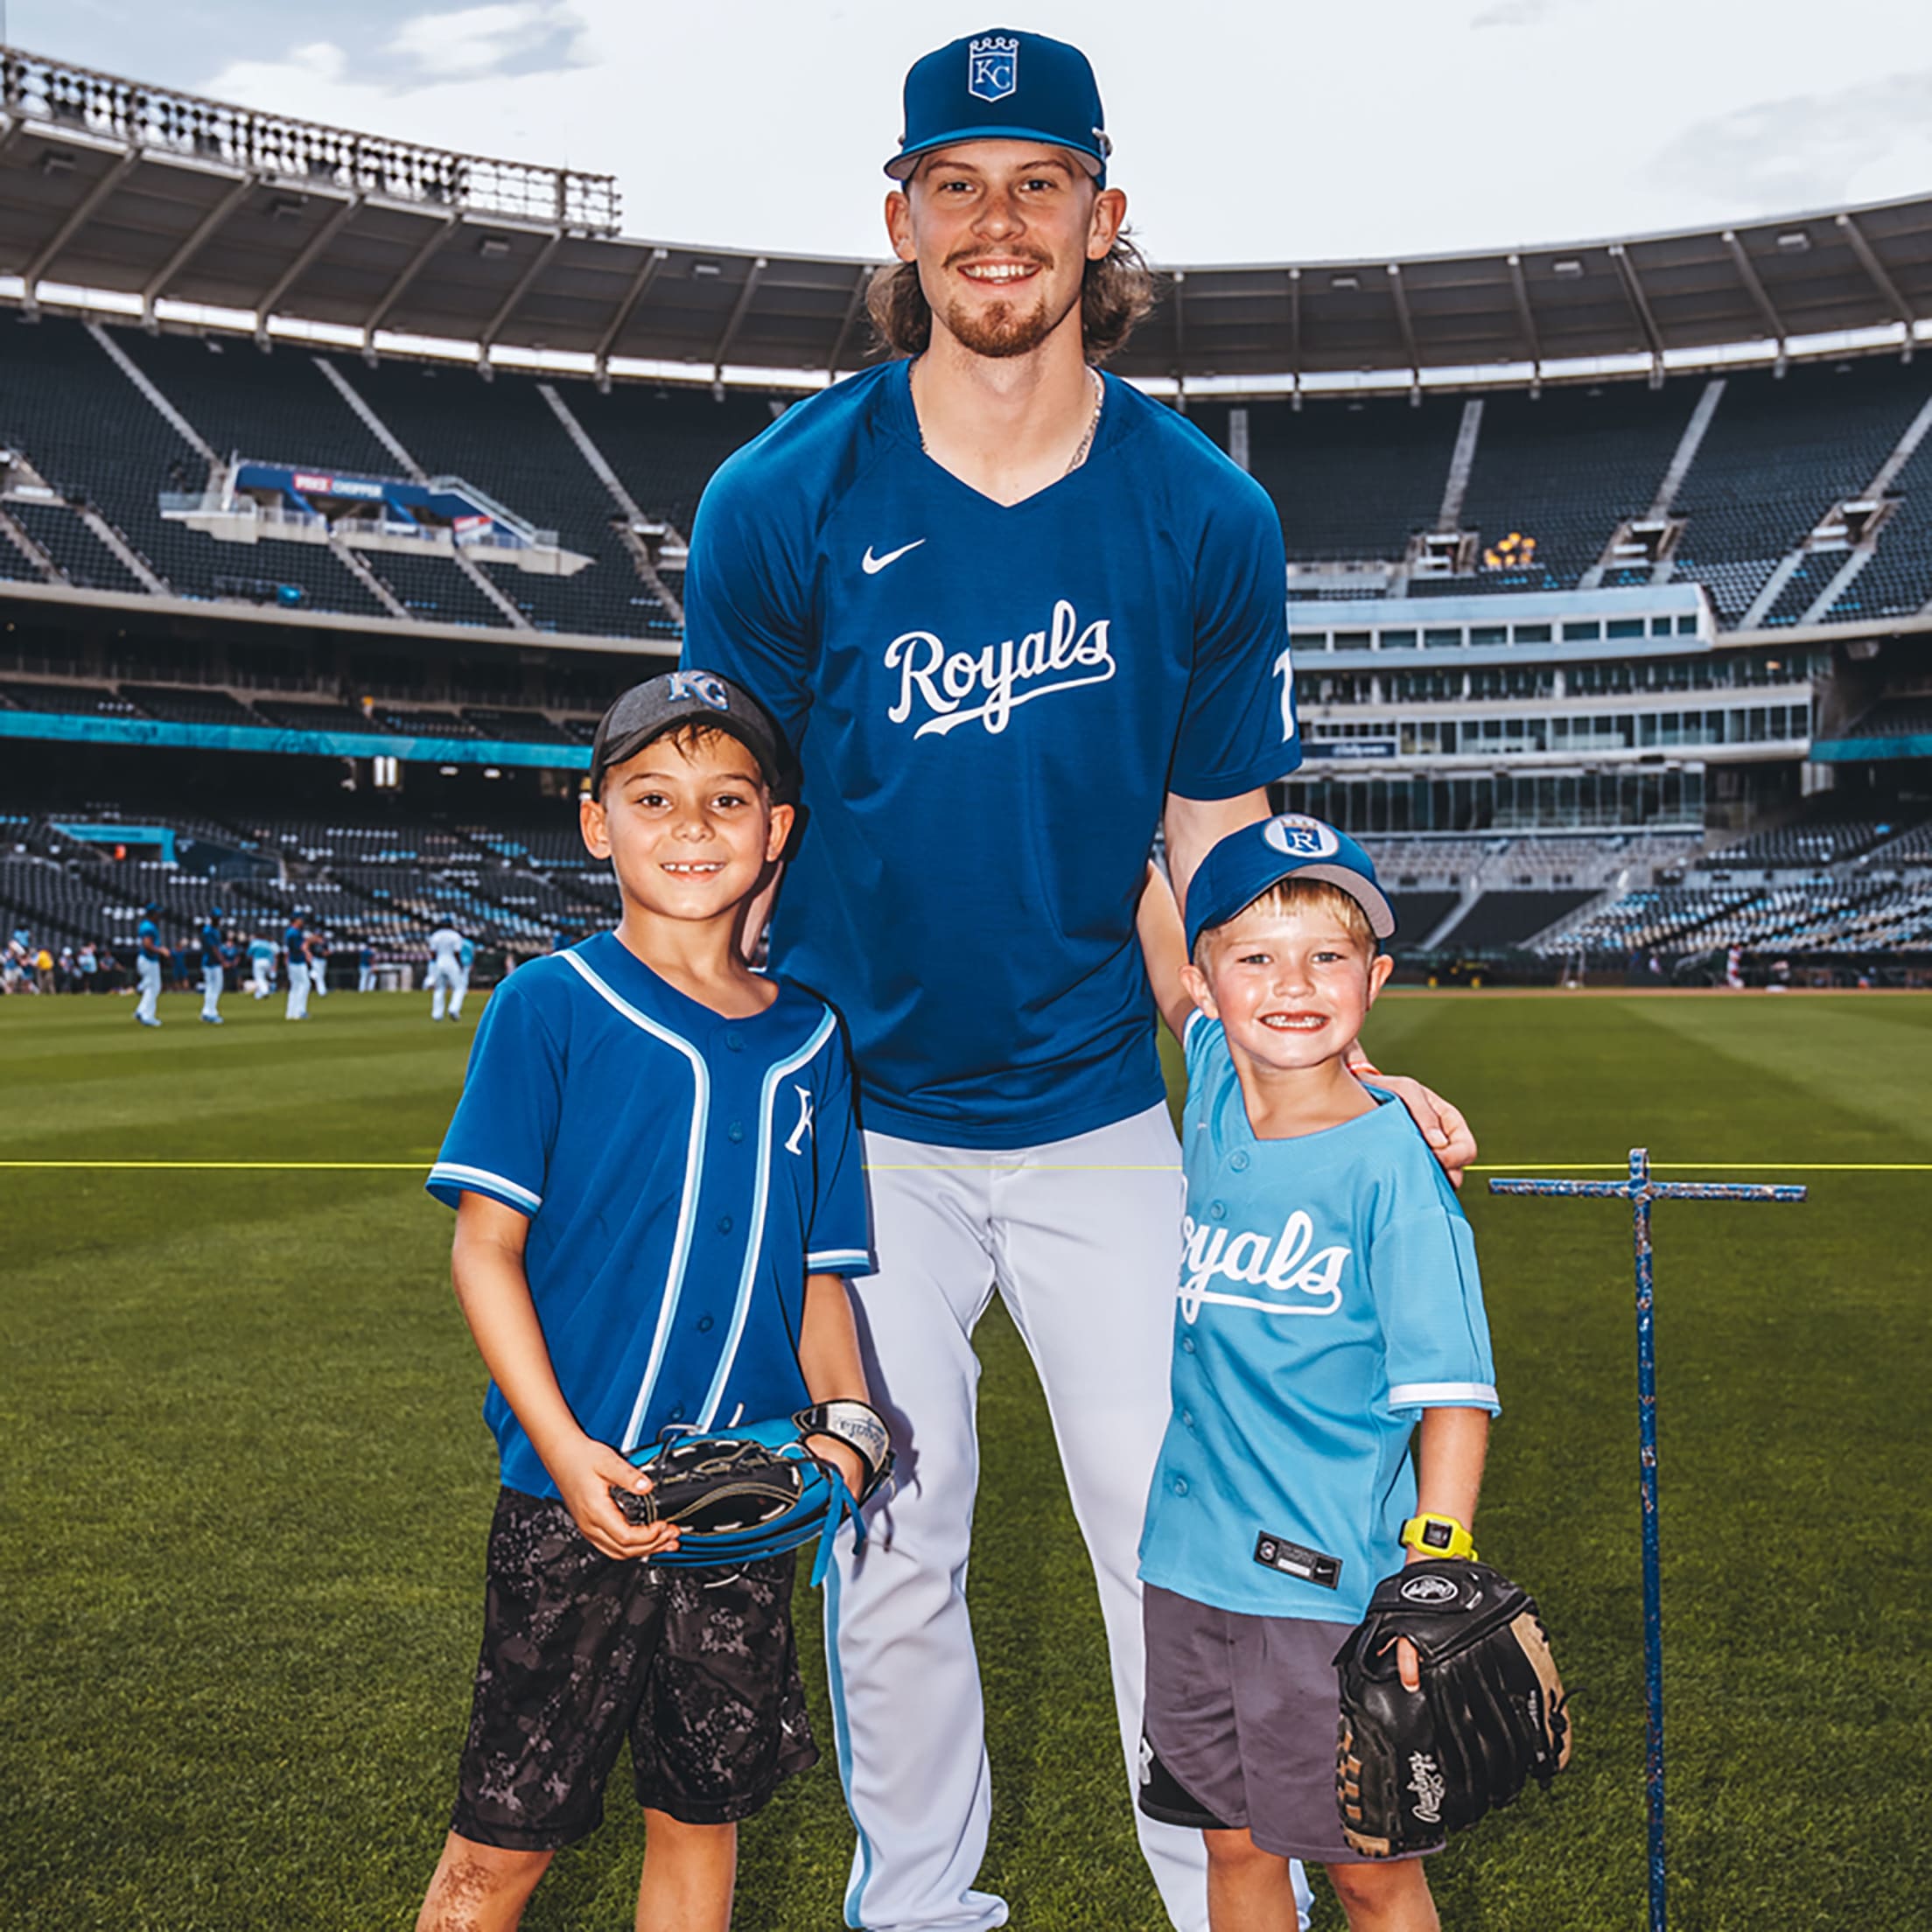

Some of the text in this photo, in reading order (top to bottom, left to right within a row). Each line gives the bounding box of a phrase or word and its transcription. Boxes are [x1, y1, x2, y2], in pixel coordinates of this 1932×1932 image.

[974, 59, 1011, 90] KC
[884, 599, 1116, 740] Royals
[667, 670, 730, 711] KC
